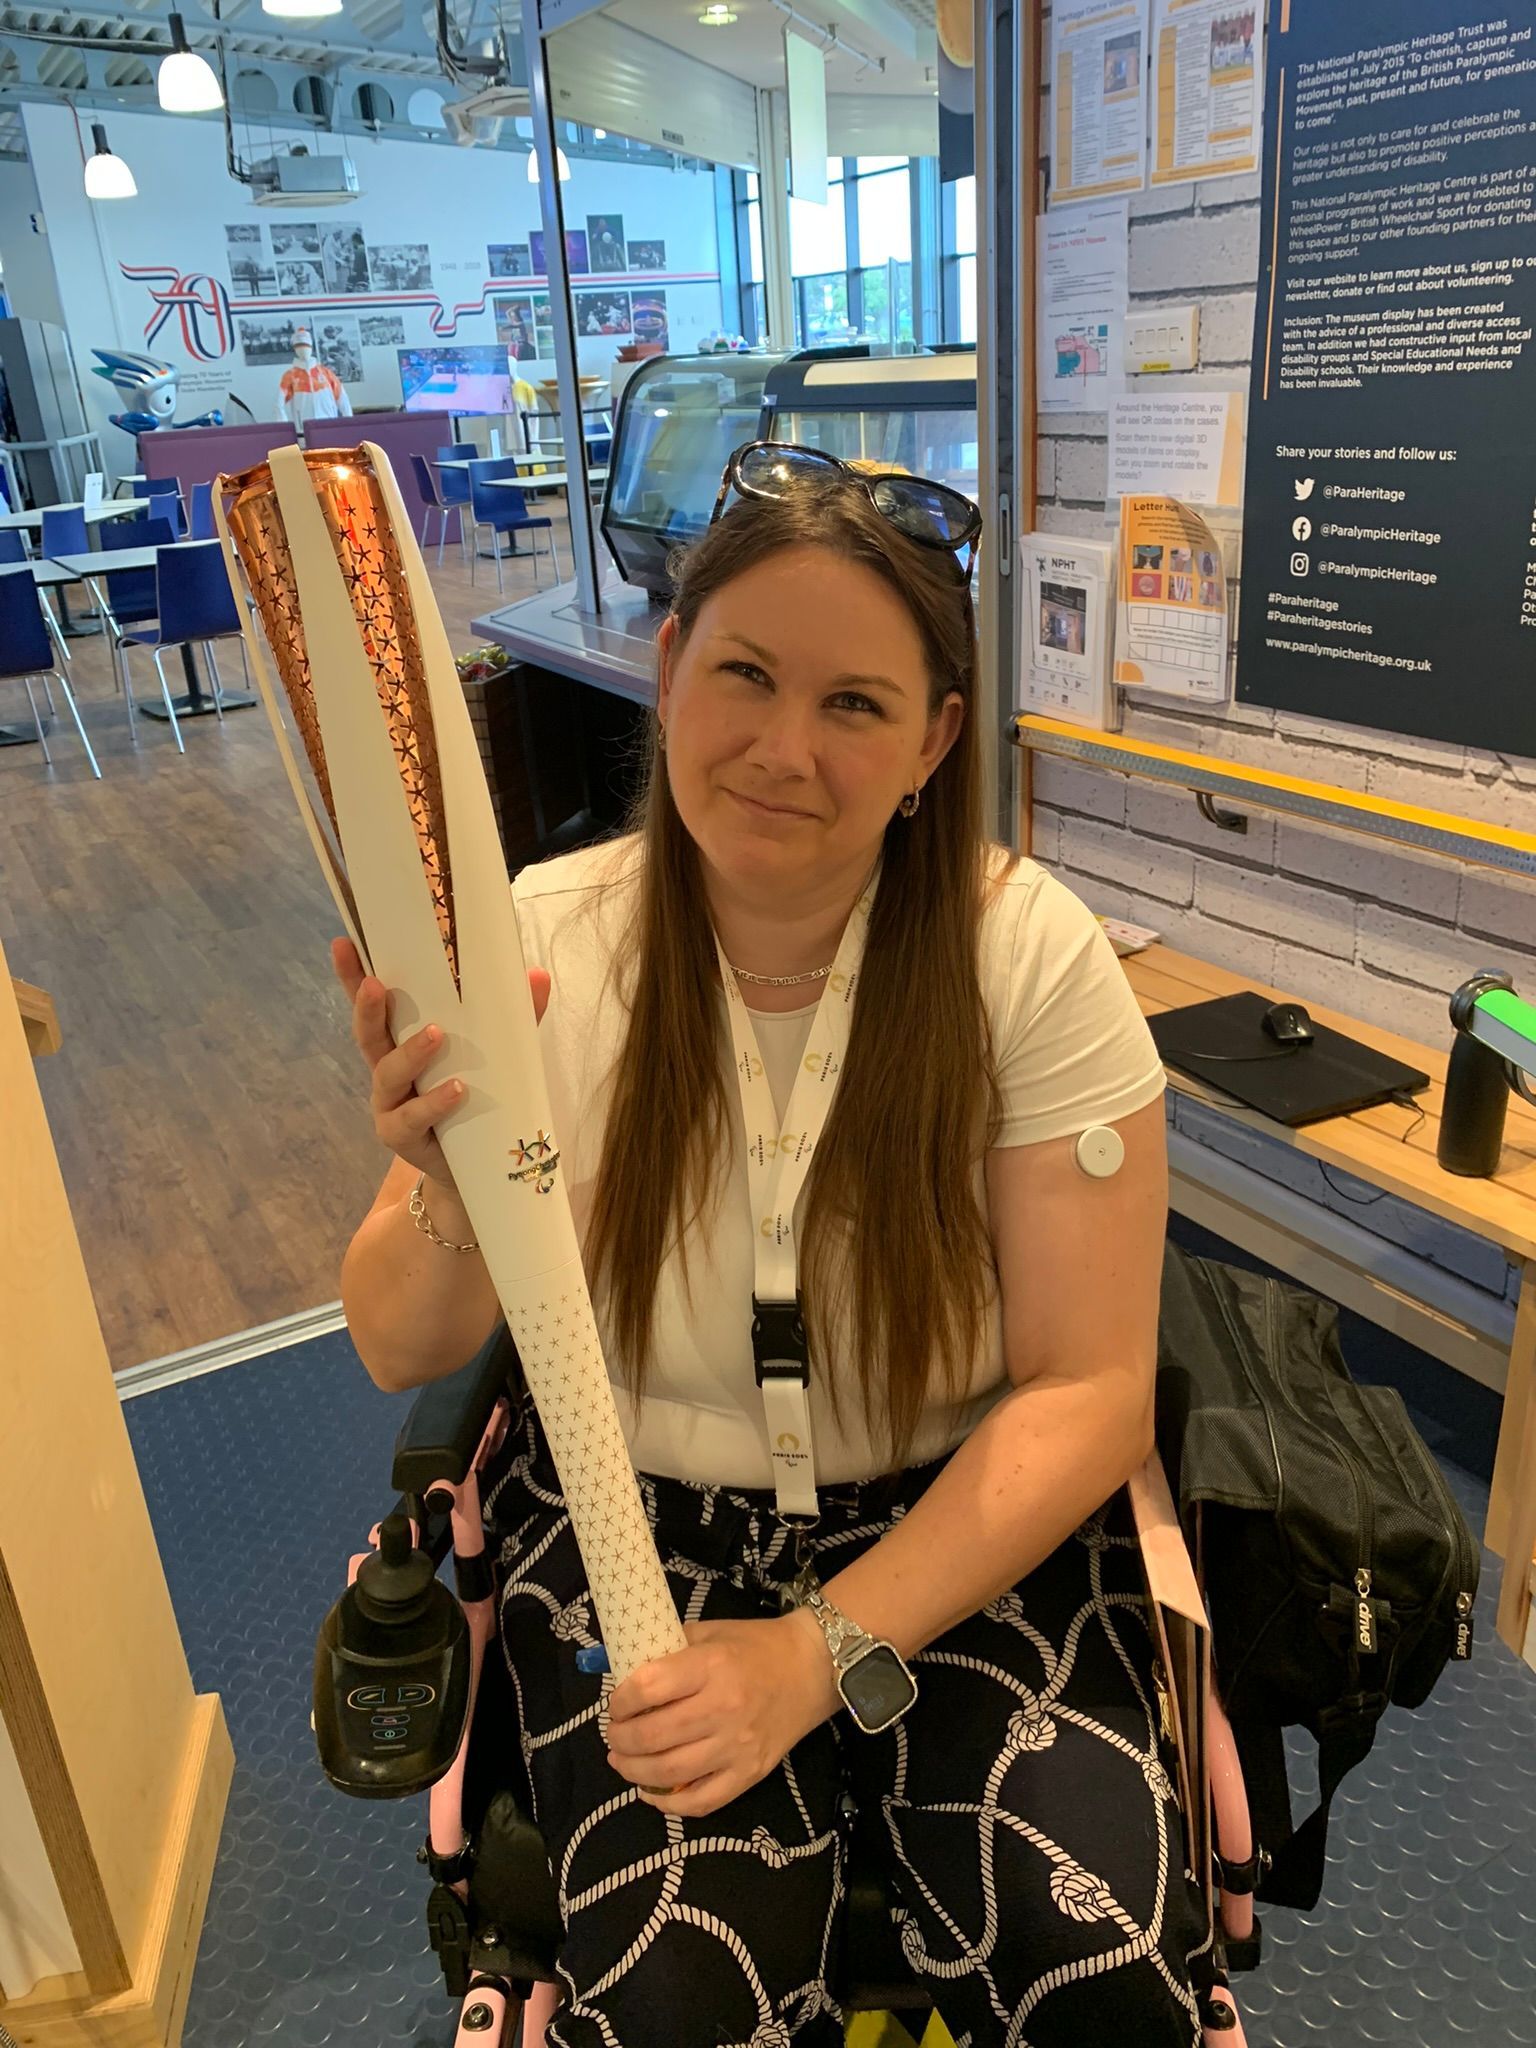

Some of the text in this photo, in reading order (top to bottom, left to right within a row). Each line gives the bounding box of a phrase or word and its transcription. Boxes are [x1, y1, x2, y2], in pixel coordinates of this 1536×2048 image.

[1297, 68, 1348, 89] established
[1350, 66, 1359, 77] in
[1362, 62, 1379, 75] July
[1383, 56, 1404, 70] 2015
[1424, 44, 1465, 62] cherish,
[1466, 37, 1507, 53] capture
[1510, 29, 1531, 43] and
[1299, 21, 1507, 74] The National Paralympic Heritage Trust was
[1296, 48, 1514, 102] explore the heritage of the British Paralympic
[1296, 58, 1536, 115] Movement, past, present and future, for generatio
[1295, 118, 1304, 129] to
[1292, 197, 1308, 209] This
[1310, 192, 1346, 207] National
[1348, 185, 1396, 201] Paralympic
[1399, 180, 1441, 194] Heritage
[1443, 175, 1477, 188] Centre
[1480, 172, 1488, 183] is
[1490, 168, 1512, 184] part
[1515, 166, 1526, 178] of
[1290, 181, 1534, 223] national programme of work and we are indebted to
[1287, 276, 1304, 288] Visit
[1307, 277, 1321, 286] our
[1324, 272, 1356, 285] website
[1358, 271, 1368, 282] to
[1370, 270, 1393, 280] learn
[1395, 268, 1420, 278] more
[1422, 262, 1451, 275] about
[1454, 264, 1468, 273] us,
[1471, 260, 1492, 272] sign
[1495, 260, 1509, 270] up
[1512, 256, 1523, 267] to
[1286, 273, 1514, 300] newsletter, donate or find out about volunteering.
[1284, 301, 1503, 326] Inclusion: The museum display has been created
[1282, 328, 1531, 351] team. In addition we had constructive input from local
[1283, 317, 1520, 339] with the advice of a professional and diverse access
[1282, 343, 1521, 365] disability groups and Special Educational Needs and
[1280, 358, 1512, 377] Disability schools. Their knowledge and experience
[1280, 376, 1363, 388] has been invaluable.
[1276, 446, 1456, 460] Share your stories and follow us:
[1323, 485, 1406, 502] @ParaHeritage
[1134, 503, 1163, 511] Letter
[1320, 523, 1441, 545] @ParalympicHeritage
[1052, 558, 1076, 570] NPHT
[1318, 561, 1437, 584] @ParalympicHeritage
[1268, 592, 1339, 612] #Paraheritage
[1267, 610, 1373, 634] #Paraheritagestories
[1265, 637, 1432, 672] www.paralympicheritage.org.uk
[1358, 1602, 1372, 1647] drive
[1456, 1623, 1470, 1656] drive
